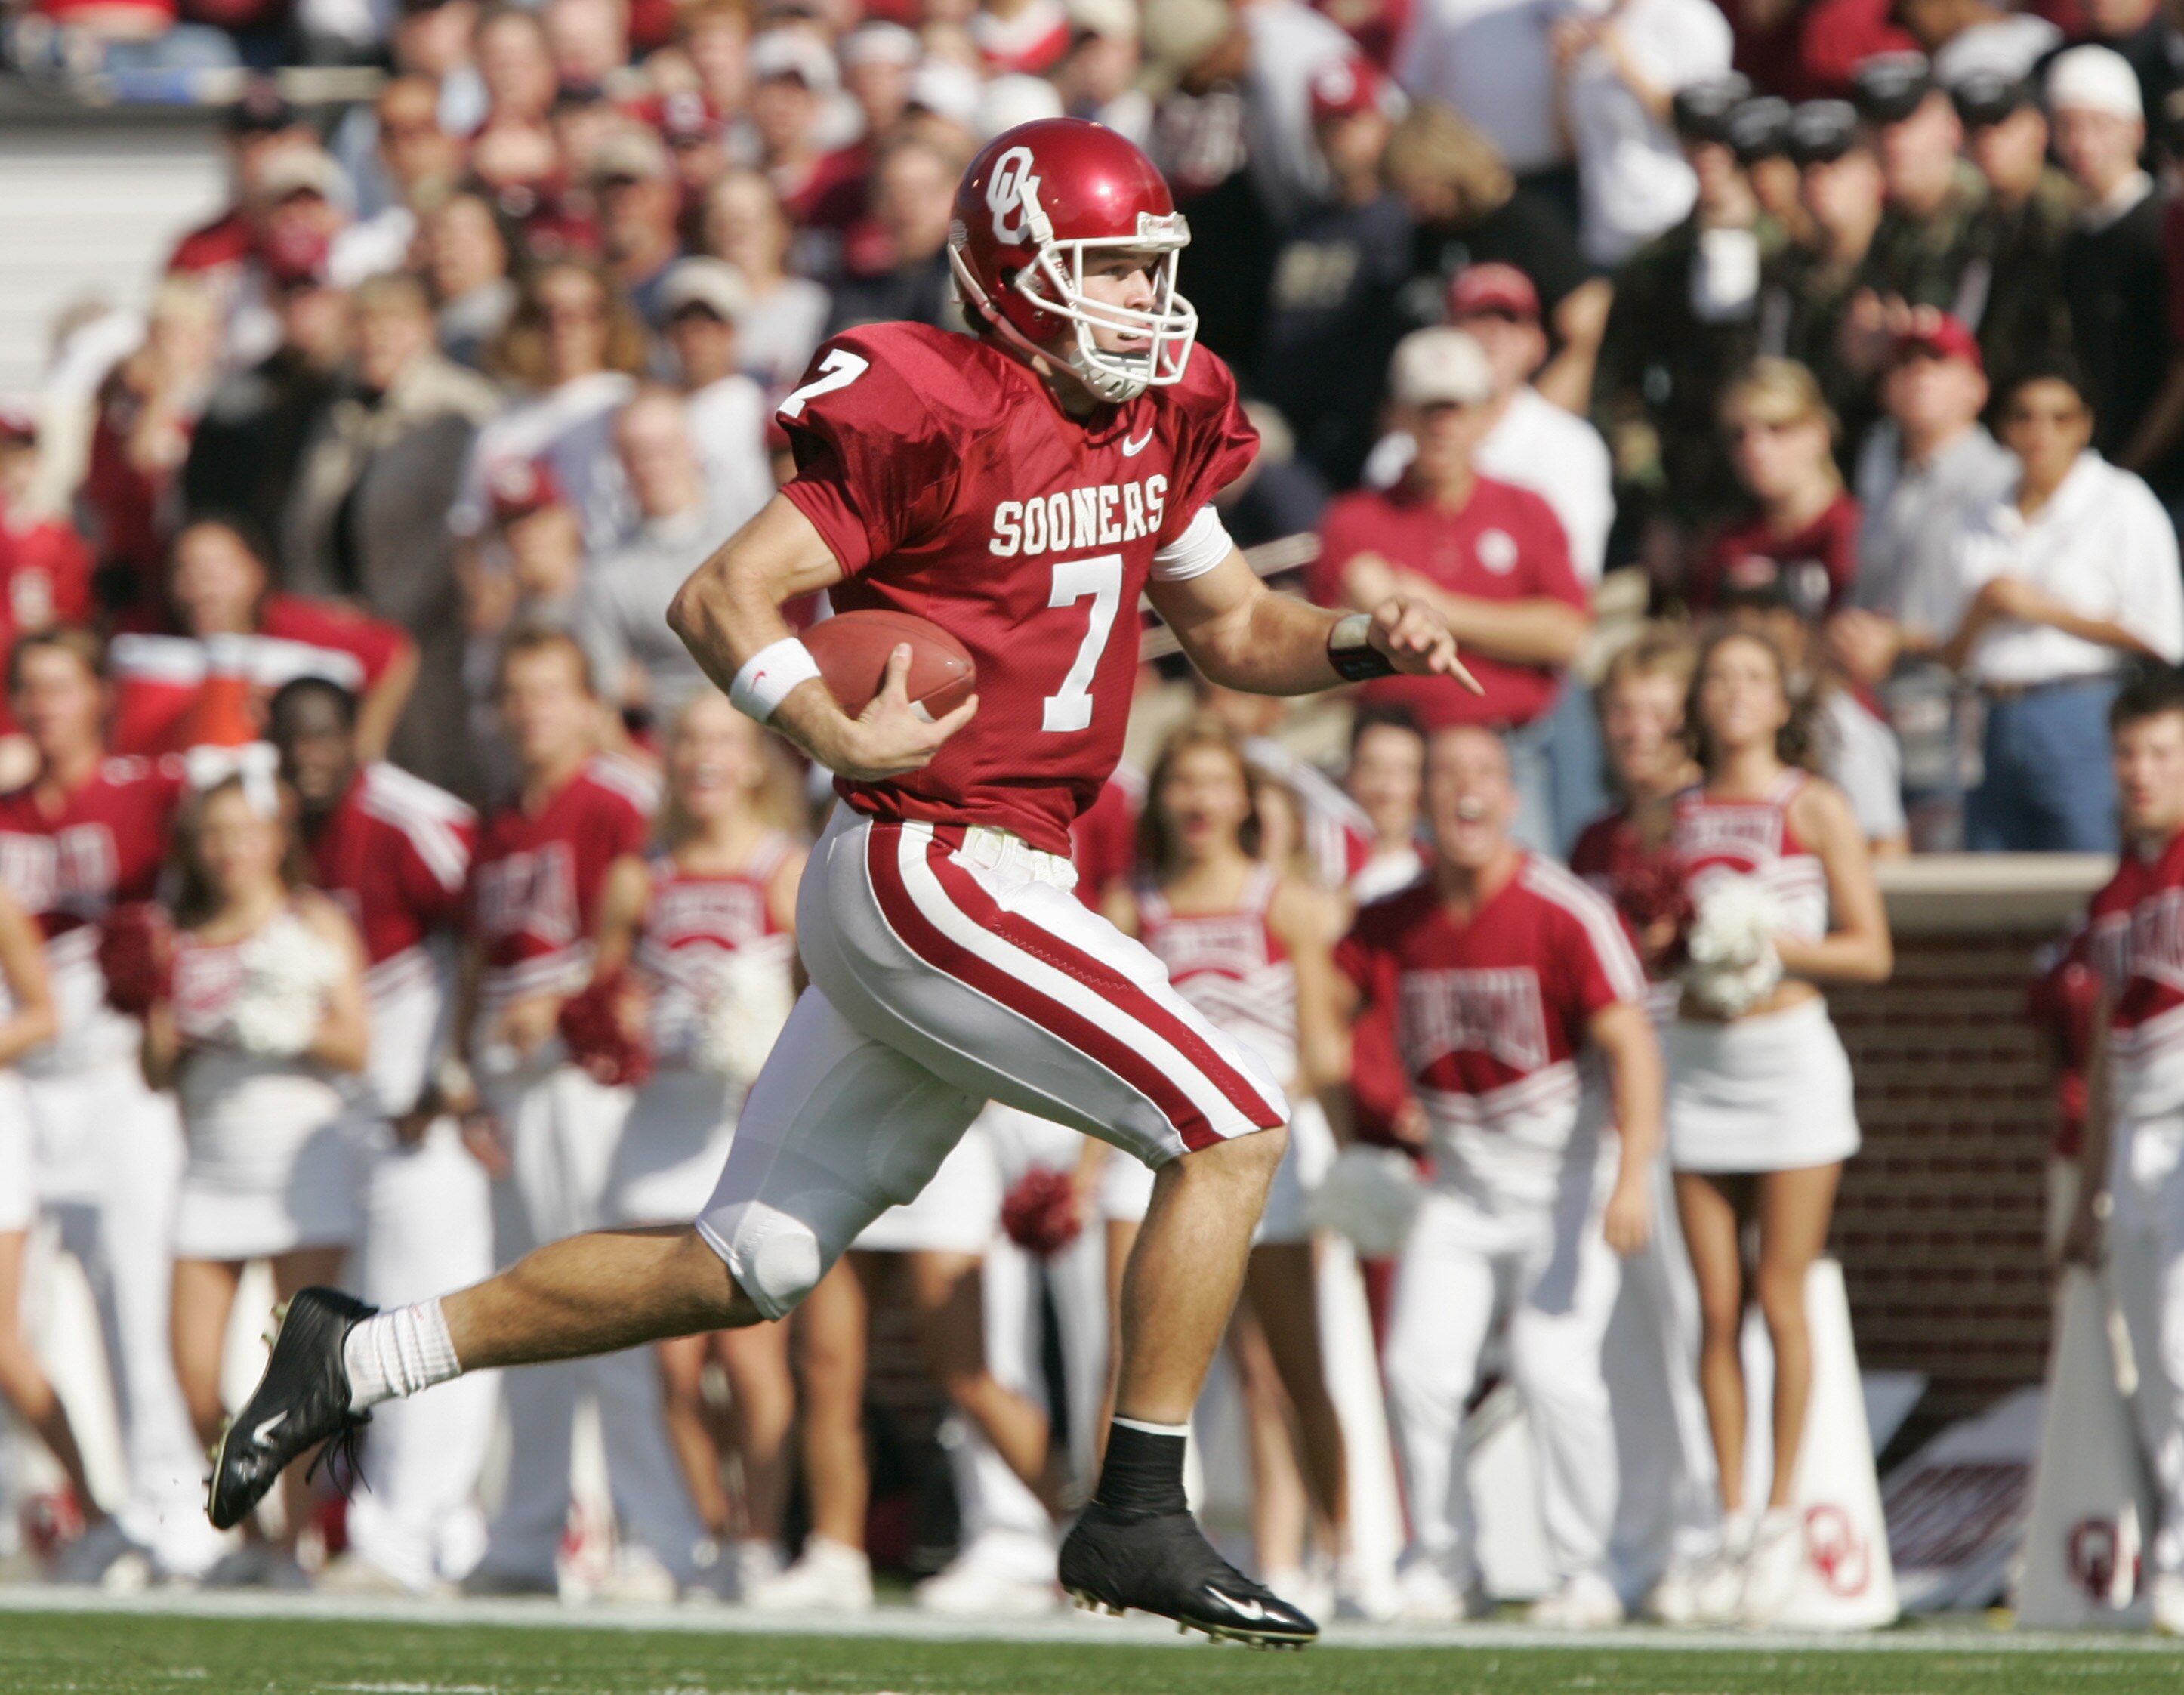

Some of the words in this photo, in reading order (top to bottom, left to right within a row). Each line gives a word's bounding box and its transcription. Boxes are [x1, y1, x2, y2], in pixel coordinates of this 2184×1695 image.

[986, 146, 1041, 245] OU
[777, 348, 870, 418] 7
[989, 474, 1168, 557] SOONERS
[1041, 554, 1124, 732] 7
